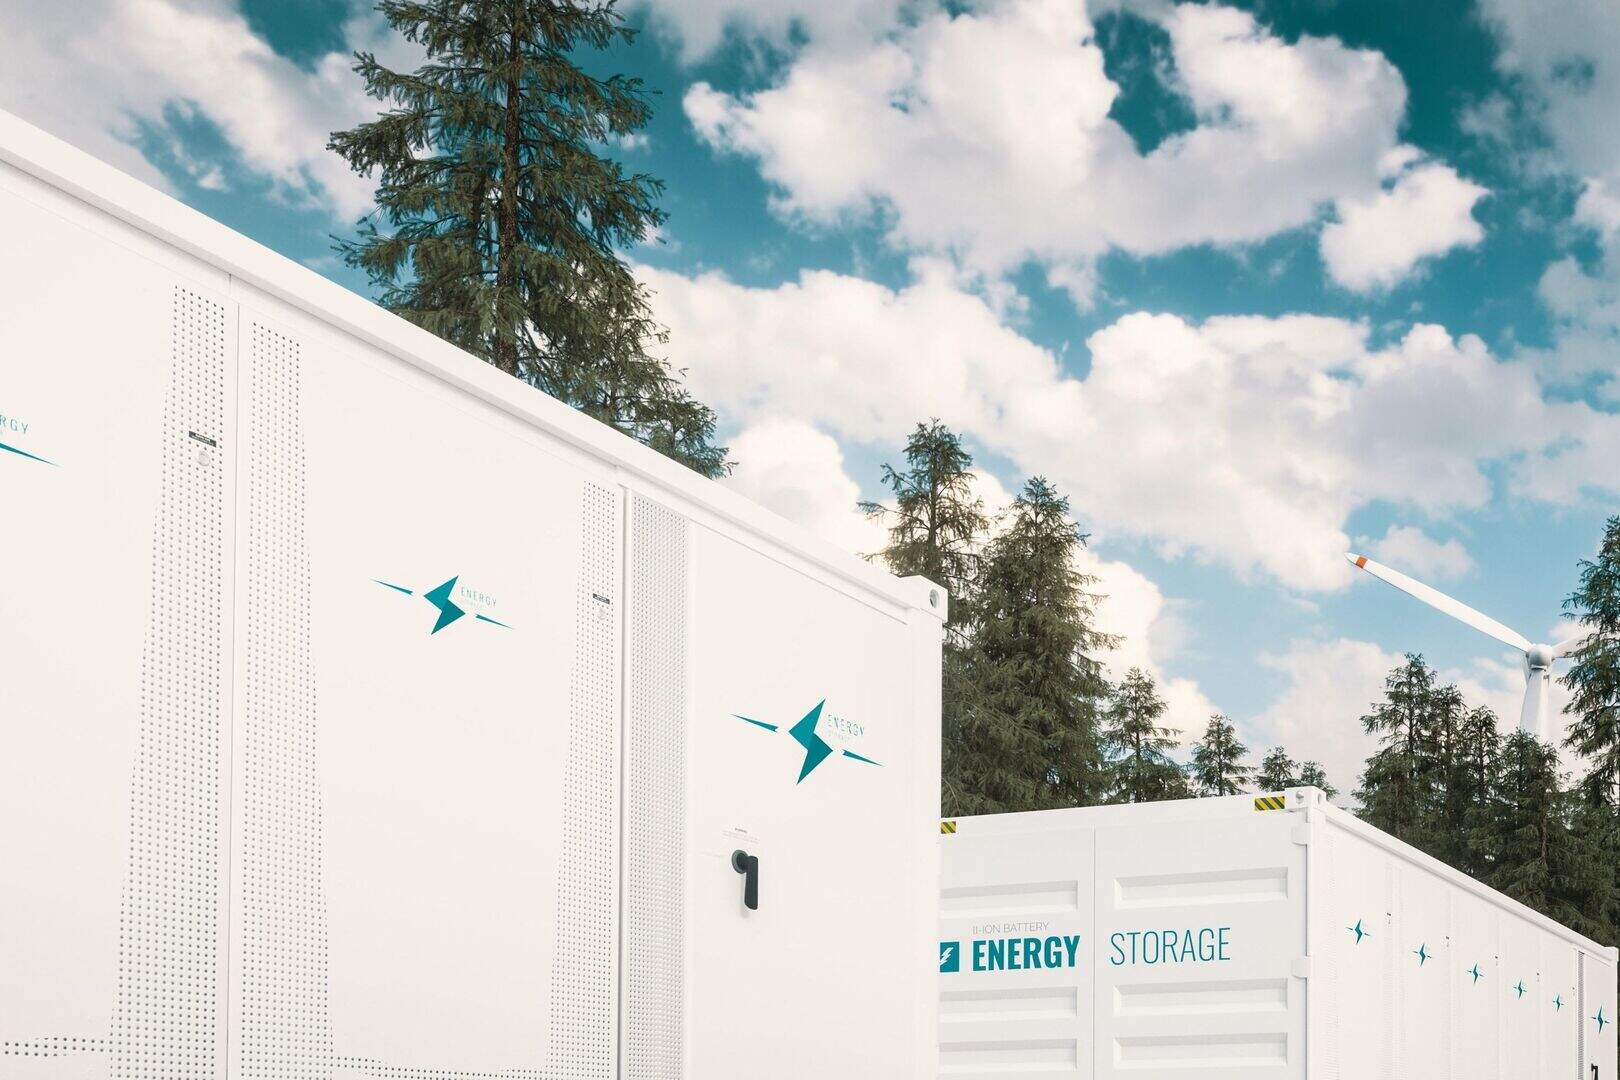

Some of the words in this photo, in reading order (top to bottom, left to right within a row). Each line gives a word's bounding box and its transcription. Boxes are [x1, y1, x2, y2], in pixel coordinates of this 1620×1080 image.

[461, 586, 497, 608] ENERGY
[827, 713, 865, 737] ENERGY
[1003, 921, 1049, 933] BATTERY
[972, 934, 1081, 972] ENERGY
[1110, 926, 1231, 966] STORAGE
